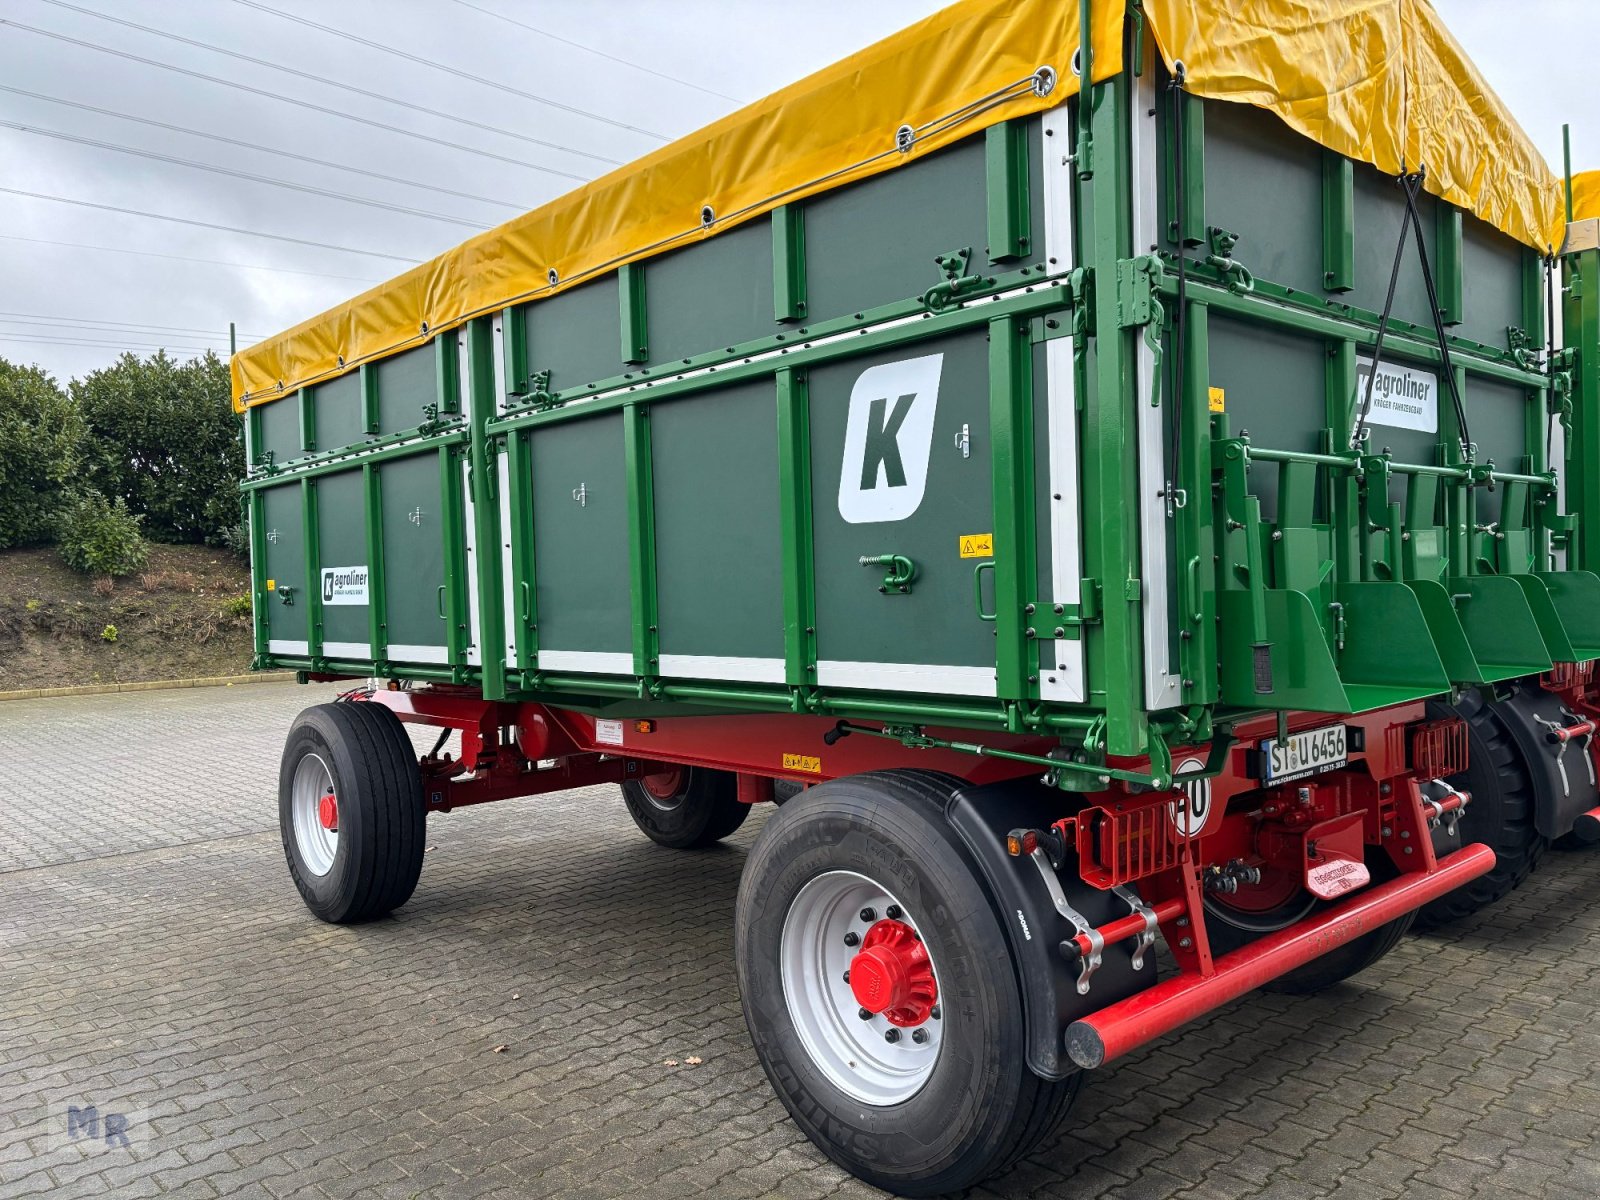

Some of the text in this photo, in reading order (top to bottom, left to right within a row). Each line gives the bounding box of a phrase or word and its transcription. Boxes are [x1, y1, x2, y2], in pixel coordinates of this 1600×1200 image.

[1375, 372, 1430, 401] agroliner
[1373, 397, 1392, 409] KRÖGER
[860, 393, 918, 491] K
[335, 569, 367, 589] agroliner
[1272, 728, 1345, 772] ST U 6456
